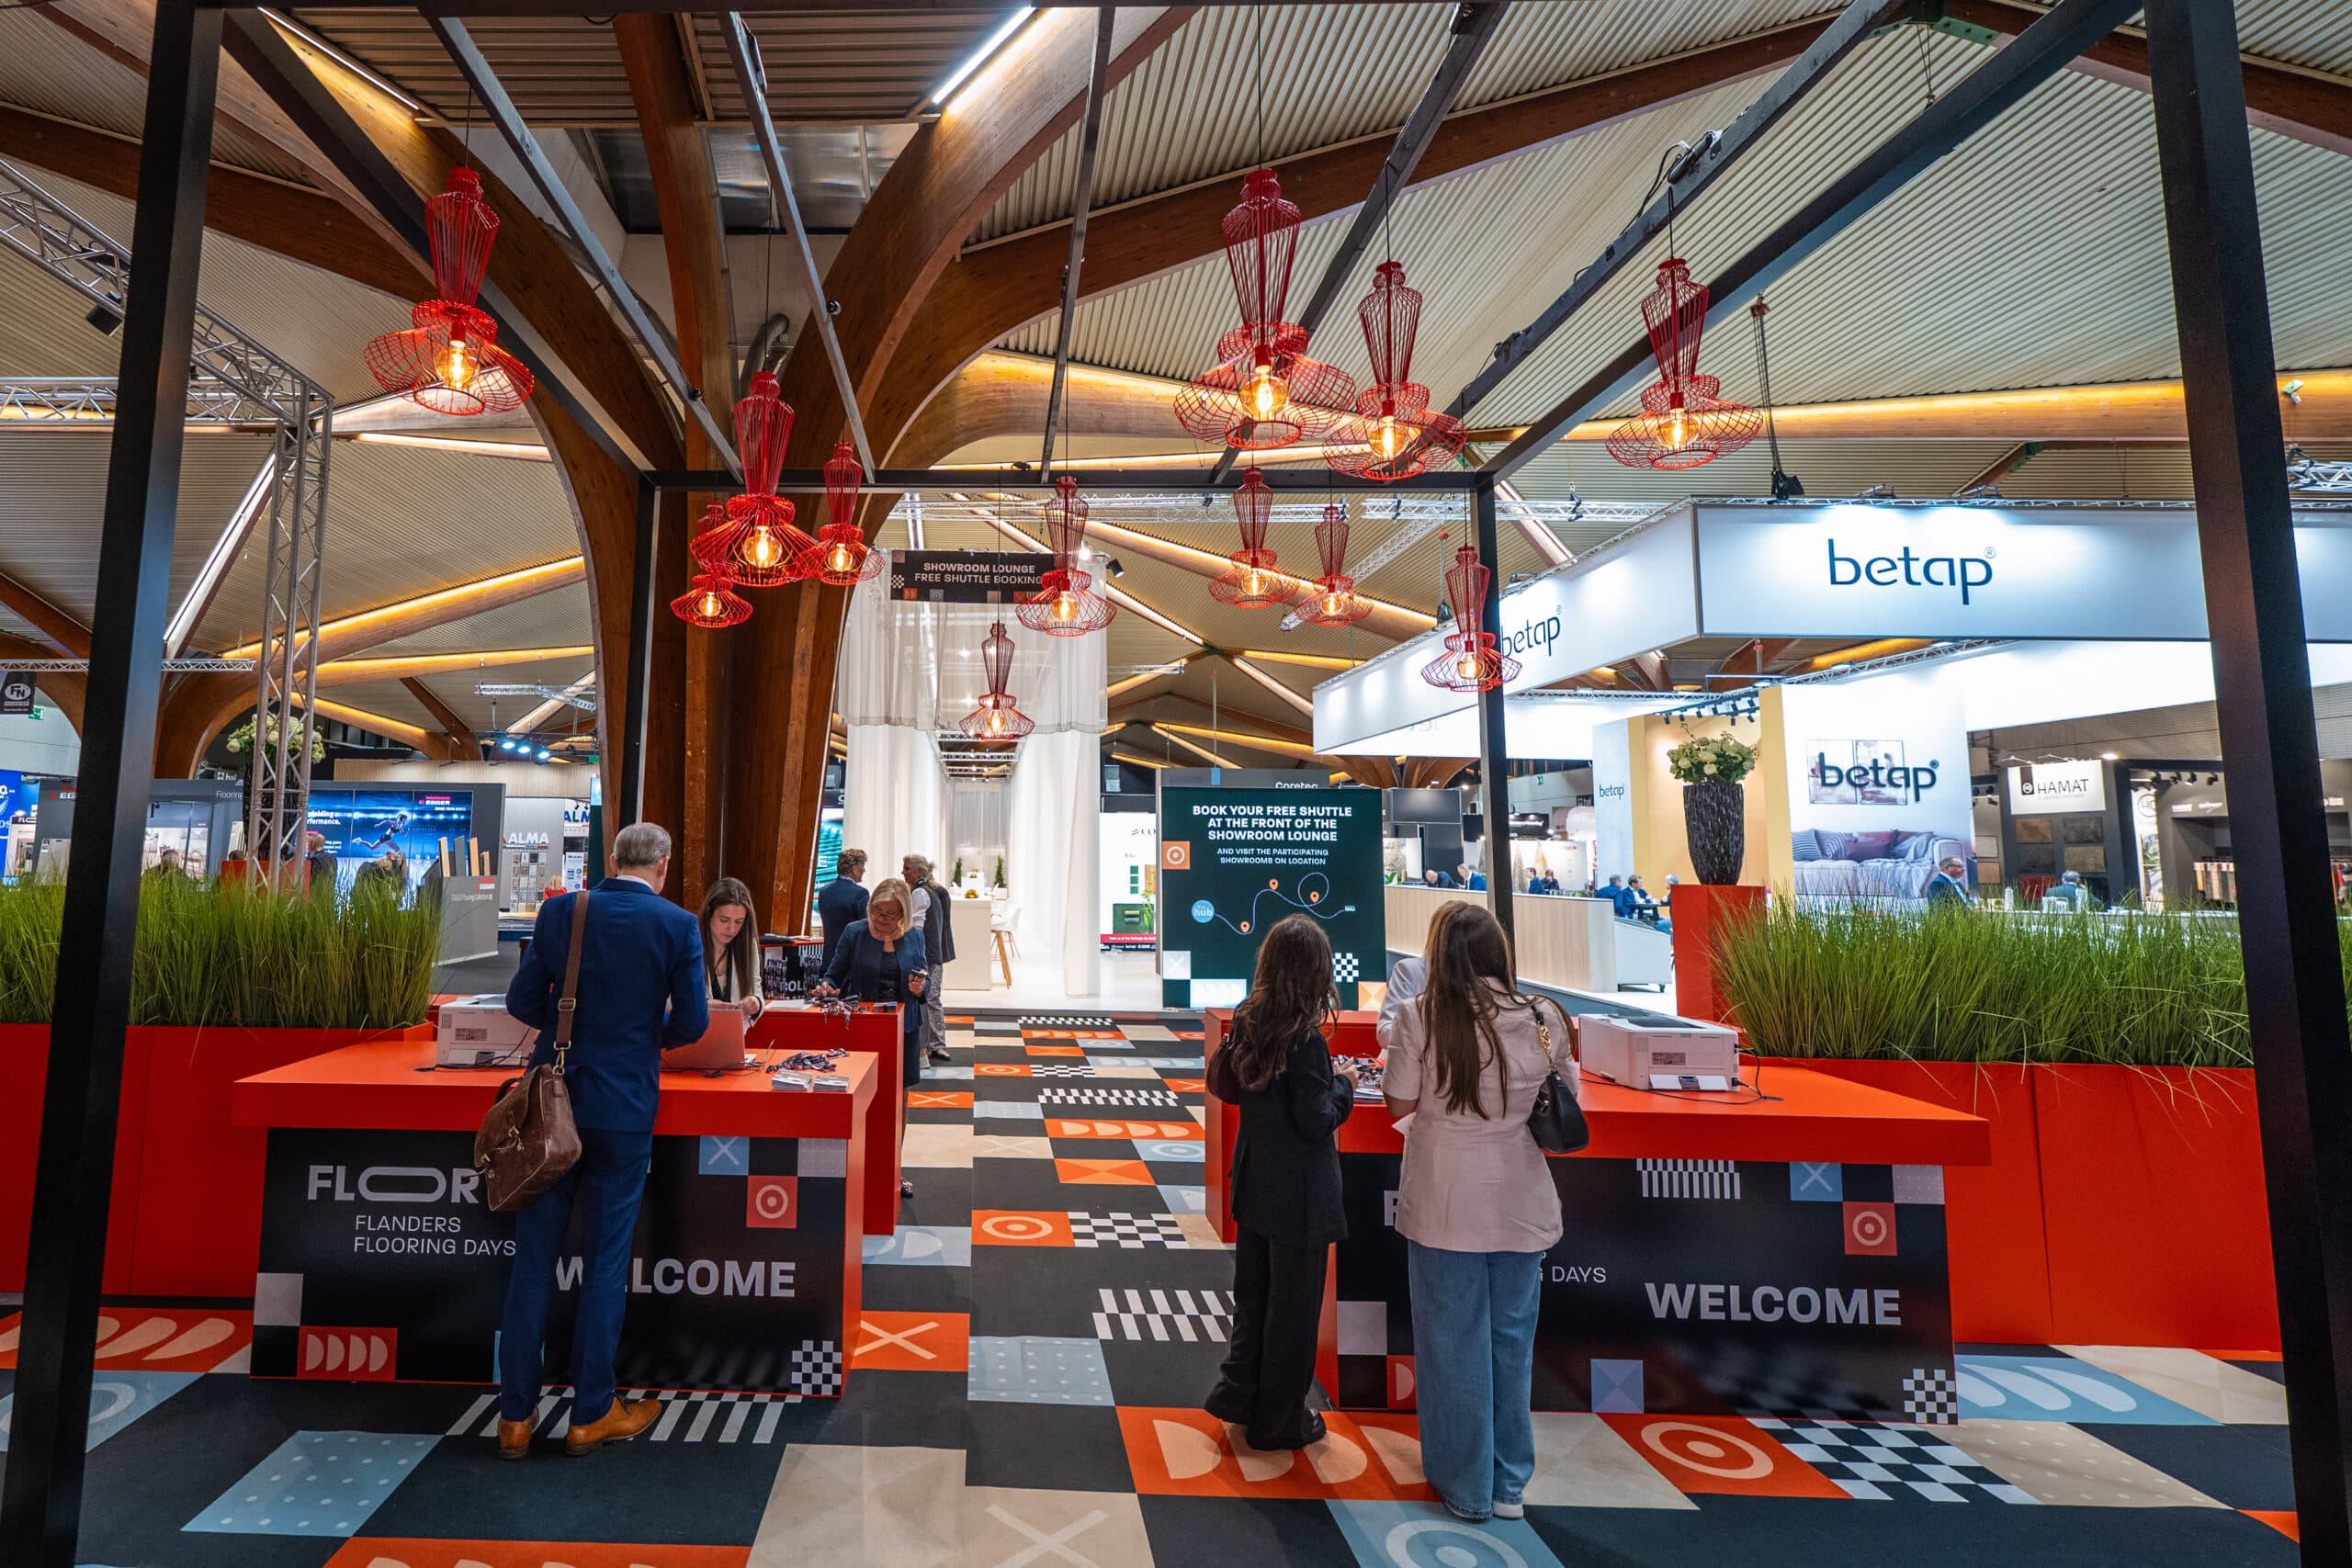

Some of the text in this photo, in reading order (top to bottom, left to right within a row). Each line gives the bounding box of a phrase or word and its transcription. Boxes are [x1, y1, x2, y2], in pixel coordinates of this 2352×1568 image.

[923, 562, 1035, 574] SHOWROOM LOUNGE
[1827, 537, 1993, 605] betap
[914, 573, 1043, 585] FREE SHUTTLE BOOKING
[1500, 616, 1561, 658] betap
[1818, 751, 1937, 803] betap
[1599, 783, 1625, 801] betap
[2037, 779, 2089, 795] HAMAT
[1193, 806, 1352, 817] BOOK YOUR FREE SHUTTLE
[307, 817, 341, 825] rformance.
[1207, 818, 1338, 829] AT THE FRONT OF THE
[508, 831, 549, 844] ALMA
[1208, 830, 1338, 841] SHOWROOM LOUNGE
[1272, 848, 1329, 856] PARTICIPATING
[1194, 908, 1213, 917] hub
[356, 1214, 461, 1233] FLANDERS
[354, 1236, 516, 1257] FLOORING DAYS
[556, 1256, 796, 1298] WLCOME
[1552, 1266, 1607, 1283] DAYS
[1645, 1282, 1902, 1325] WELCOME
